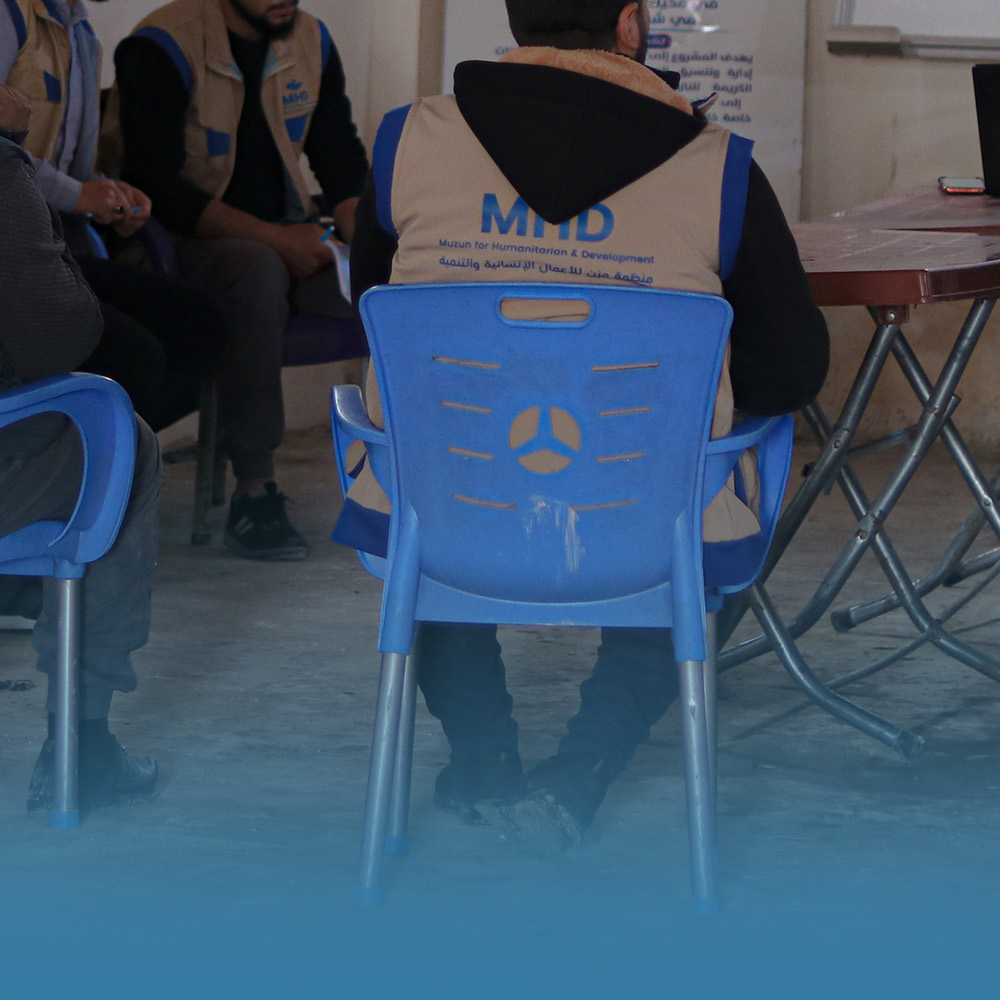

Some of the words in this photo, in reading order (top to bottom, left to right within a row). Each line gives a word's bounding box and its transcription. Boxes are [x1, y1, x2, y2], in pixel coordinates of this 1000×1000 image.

[439, 239, 471, 250] Muzun
[474, 240, 489, 250] for
[492, 242, 568, 257] Humanitarian
[571, 249, 578, 258] &
[582, 249, 655, 265] Development
[439, 256, 480, 271] والتنمية
[587, 270, 609, 279] مزن
[614, 271, 653, 284] منظمة
